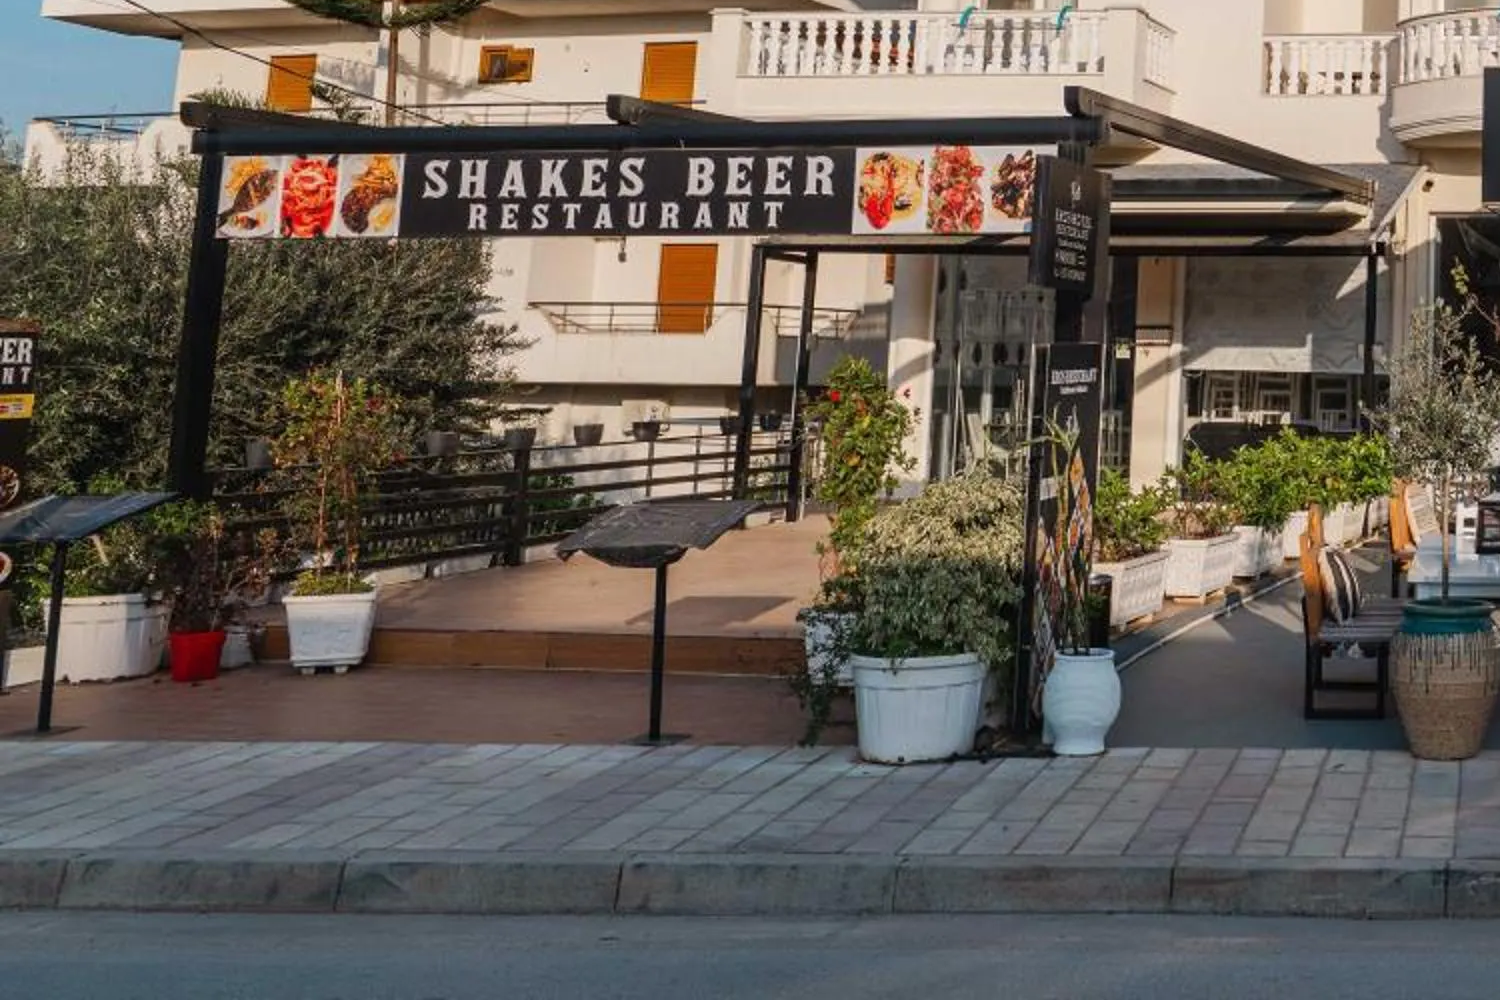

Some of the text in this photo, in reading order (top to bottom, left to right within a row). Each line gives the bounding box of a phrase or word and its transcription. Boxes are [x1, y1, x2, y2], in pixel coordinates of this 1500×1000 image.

[421, 155, 835, 199] SHAKES BEER
[466, 202, 785, 231] RESTAURANT
[0, 337, 33, 365] ER
